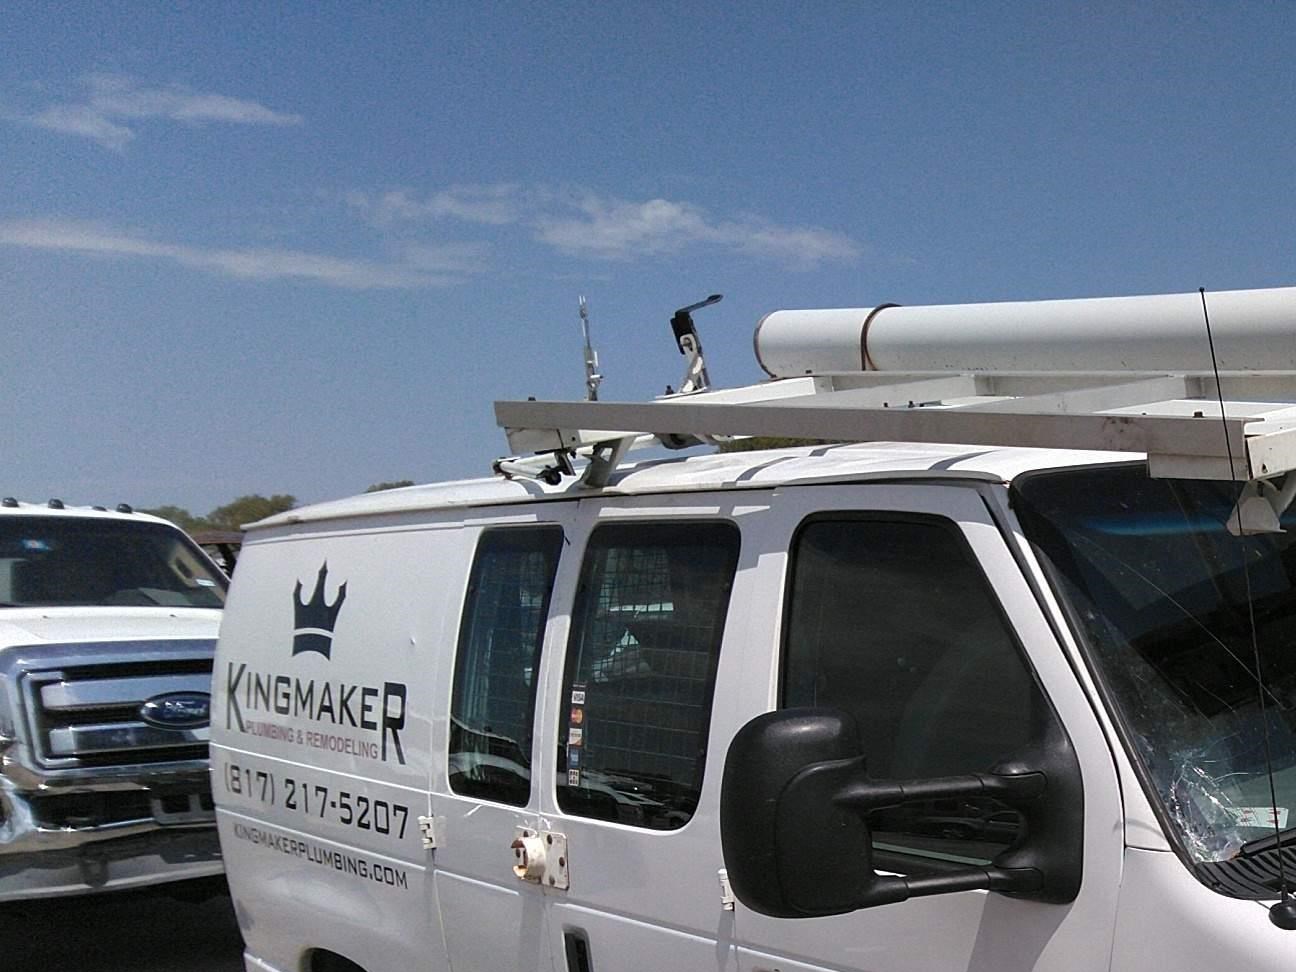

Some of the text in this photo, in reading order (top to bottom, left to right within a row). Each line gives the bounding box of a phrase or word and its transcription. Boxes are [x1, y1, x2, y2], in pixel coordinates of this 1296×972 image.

[225, 662, 406, 765] KINGMAKER
[245, 720, 378, 759] PLUMBING & REMODELING
[225, 762, 409, 839] (817) 217-5207
[233, 822, 408, 890] KINGMAKERPLUMBING.COM
